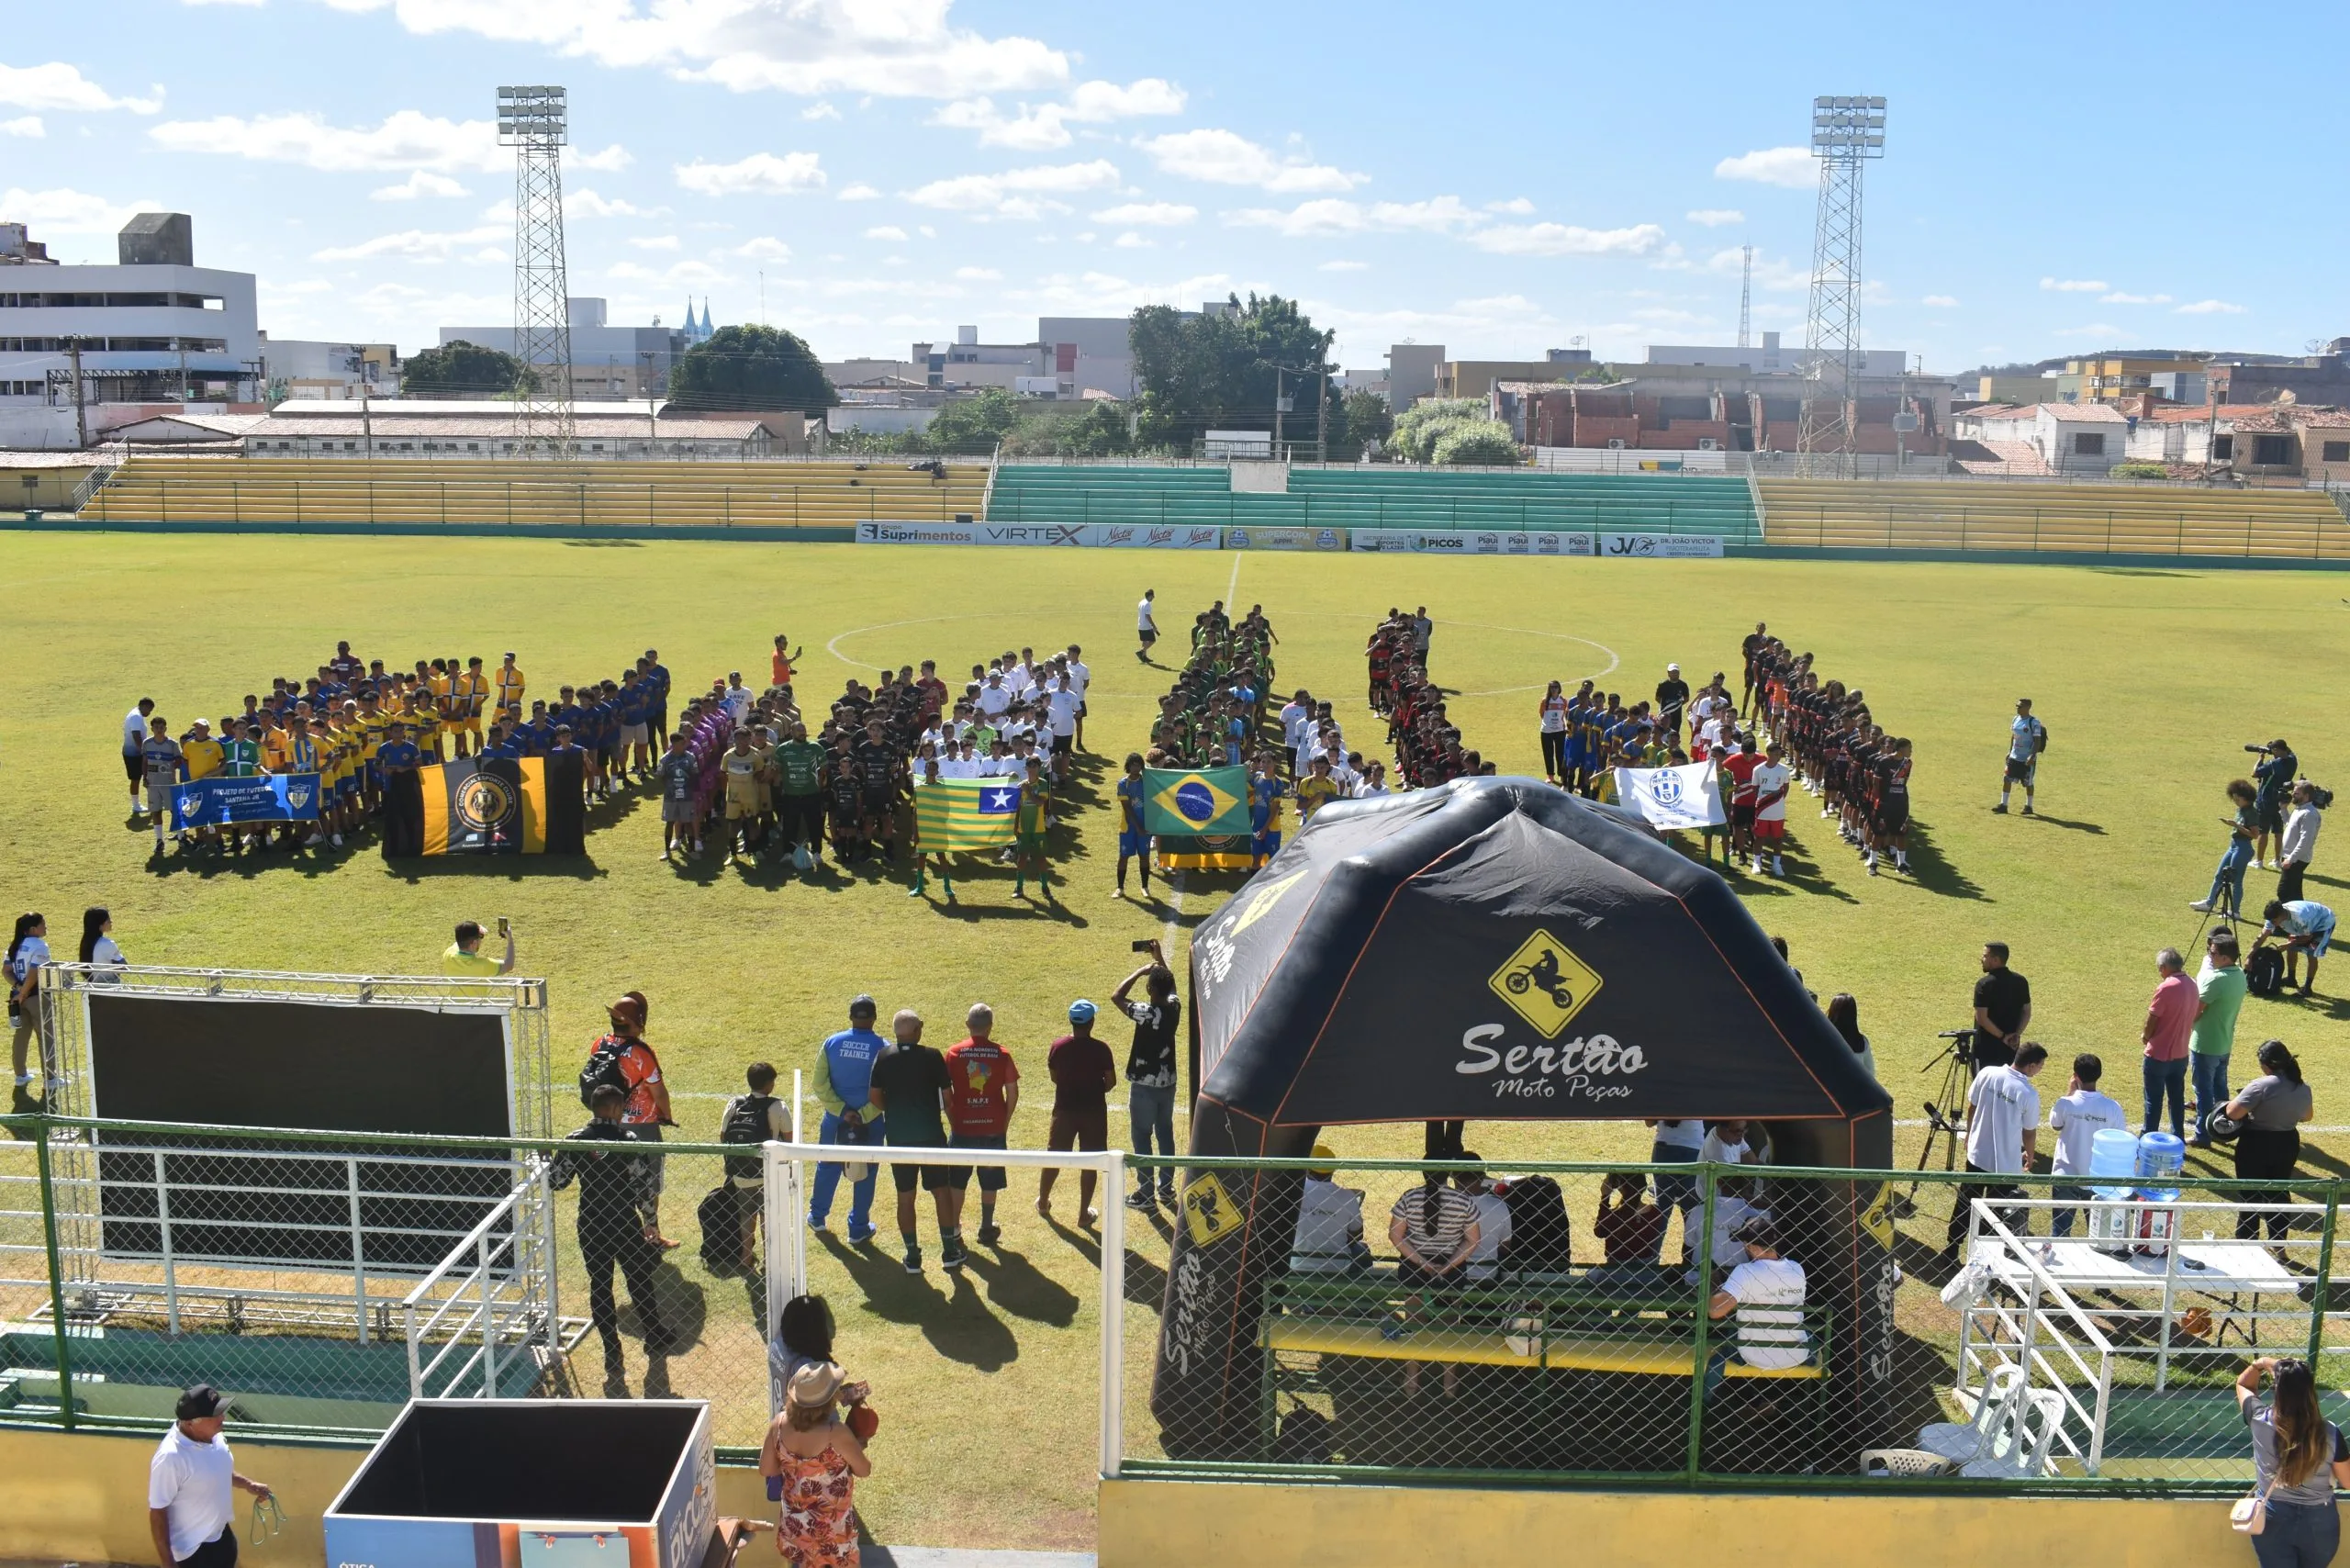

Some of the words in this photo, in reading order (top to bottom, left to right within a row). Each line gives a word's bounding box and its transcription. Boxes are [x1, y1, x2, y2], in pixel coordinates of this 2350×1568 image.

[880, 530, 972, 542] Suprimentos
[986, 525, 1087, 544] VIRTEX
[1256, 530, 1310, 540] SUPERCOPA
[843, 1040, 870, 1051] SOCCER
[1456, 1024, 1649, 1075] Sertão
[839, 1049, 870, 1060] TRAINER
[1492, 1077, 1555, 1097] Moto
[1566, 1074, 1633, 1102] Peças
